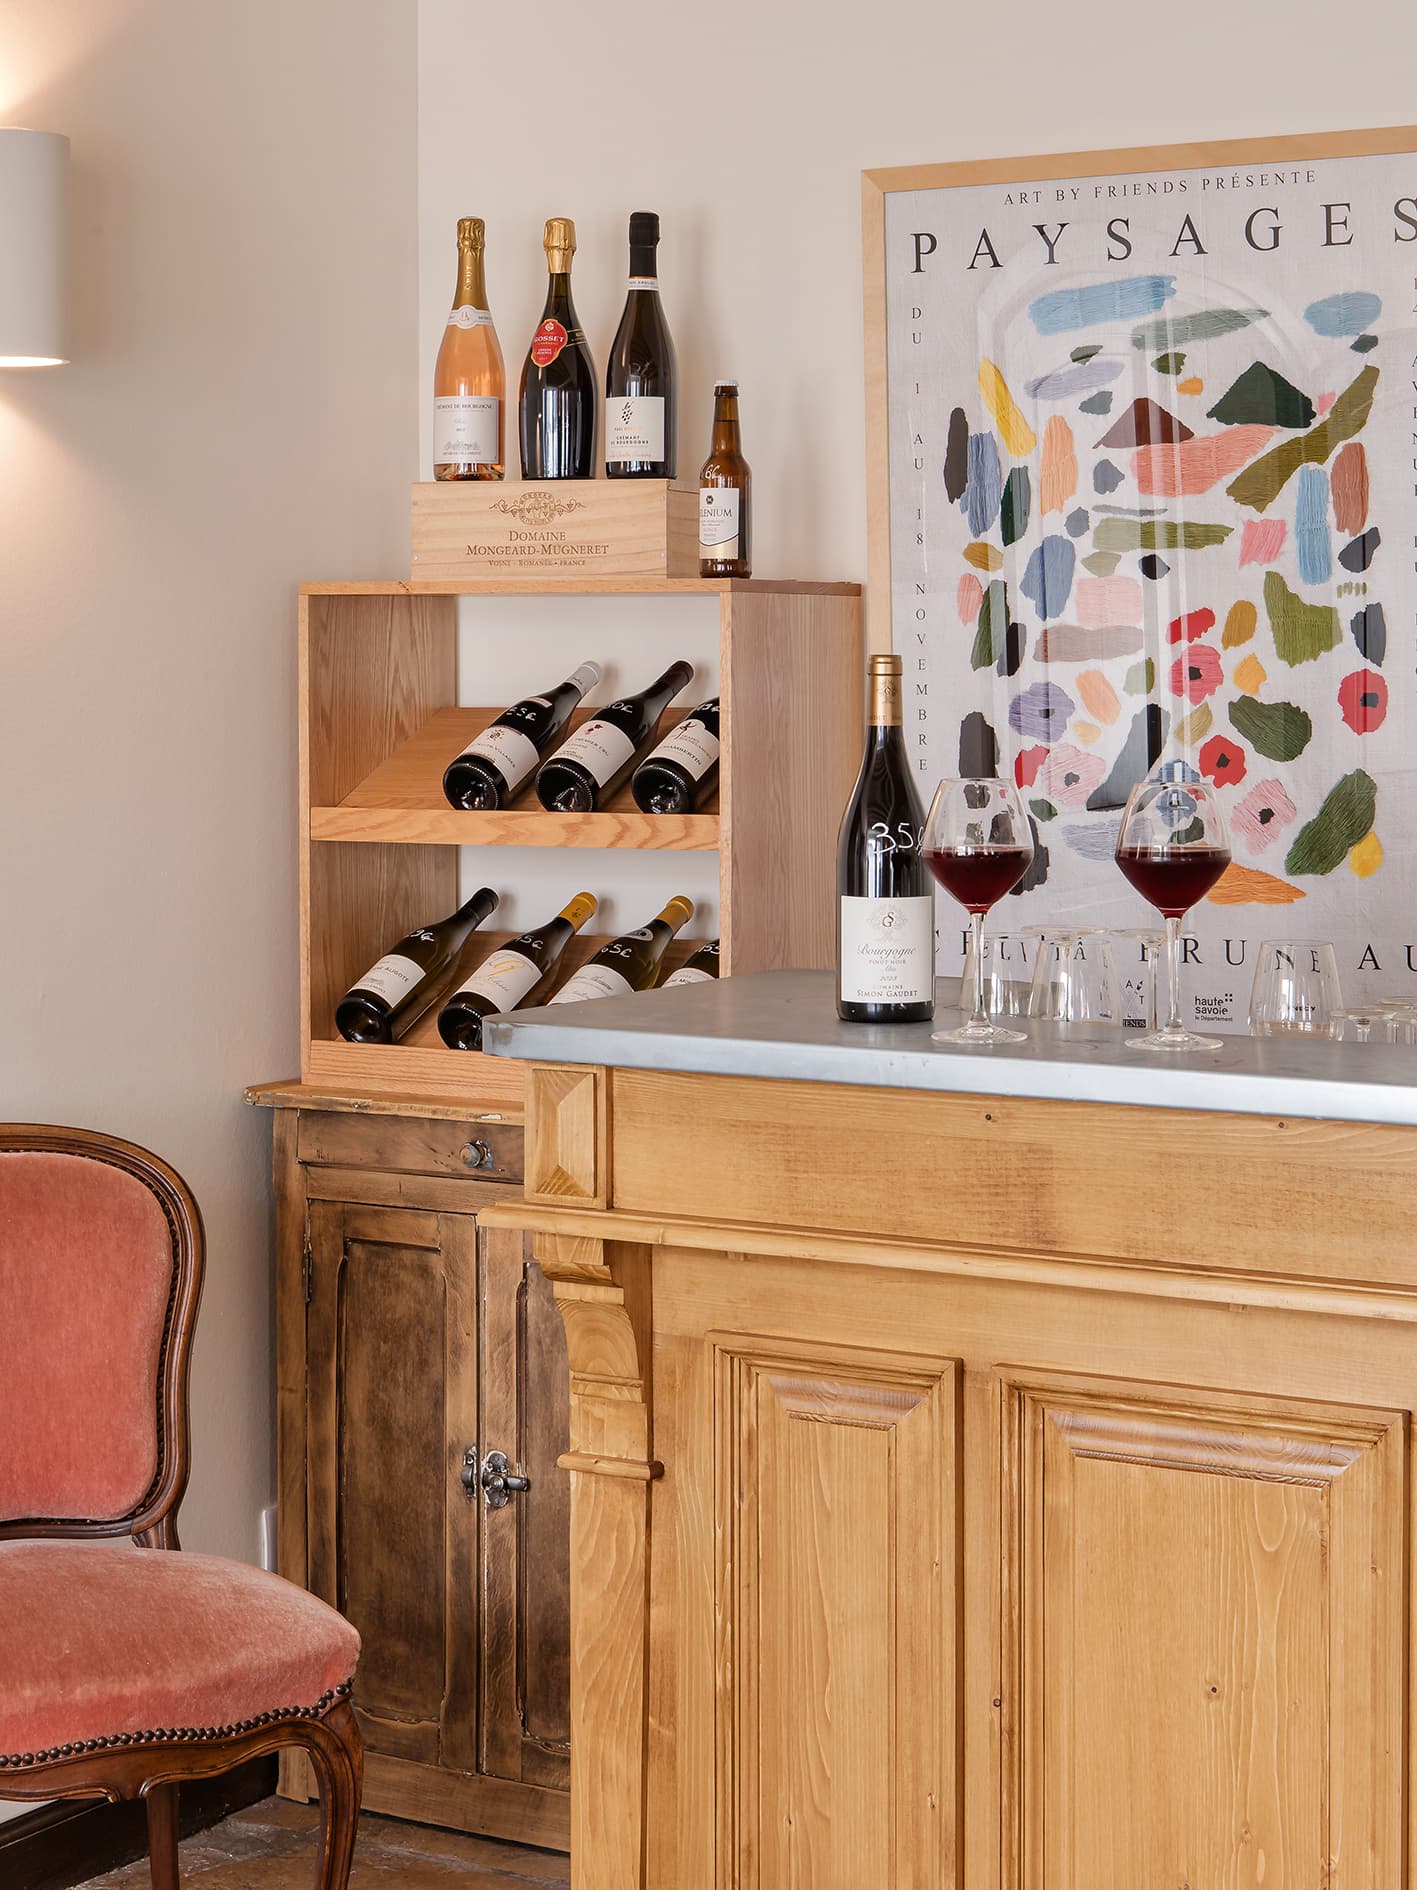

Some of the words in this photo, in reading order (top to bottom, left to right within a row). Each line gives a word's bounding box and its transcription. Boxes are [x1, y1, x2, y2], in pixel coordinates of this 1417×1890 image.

[1003, 191, 1043, 205] ART
[1055, 188, 1082, 202] BY
[1094, 180, 1189, 199] FRIENDS
[1201, 170, 1317, 191] PRÉSENTE
[911, 198, 1417, 274] PAYSAGES
[509, 530, 566, 542] DOMAINE
[466, 544, 609, 556] MONGEARD-MUGNERET
[857, 989, 883, 997] SIMON
[886, 989, 918, 998] GAUDET
[1194, 995, 1224, 1006] haute
[1195, 1006, 1228, 1015] savoie
